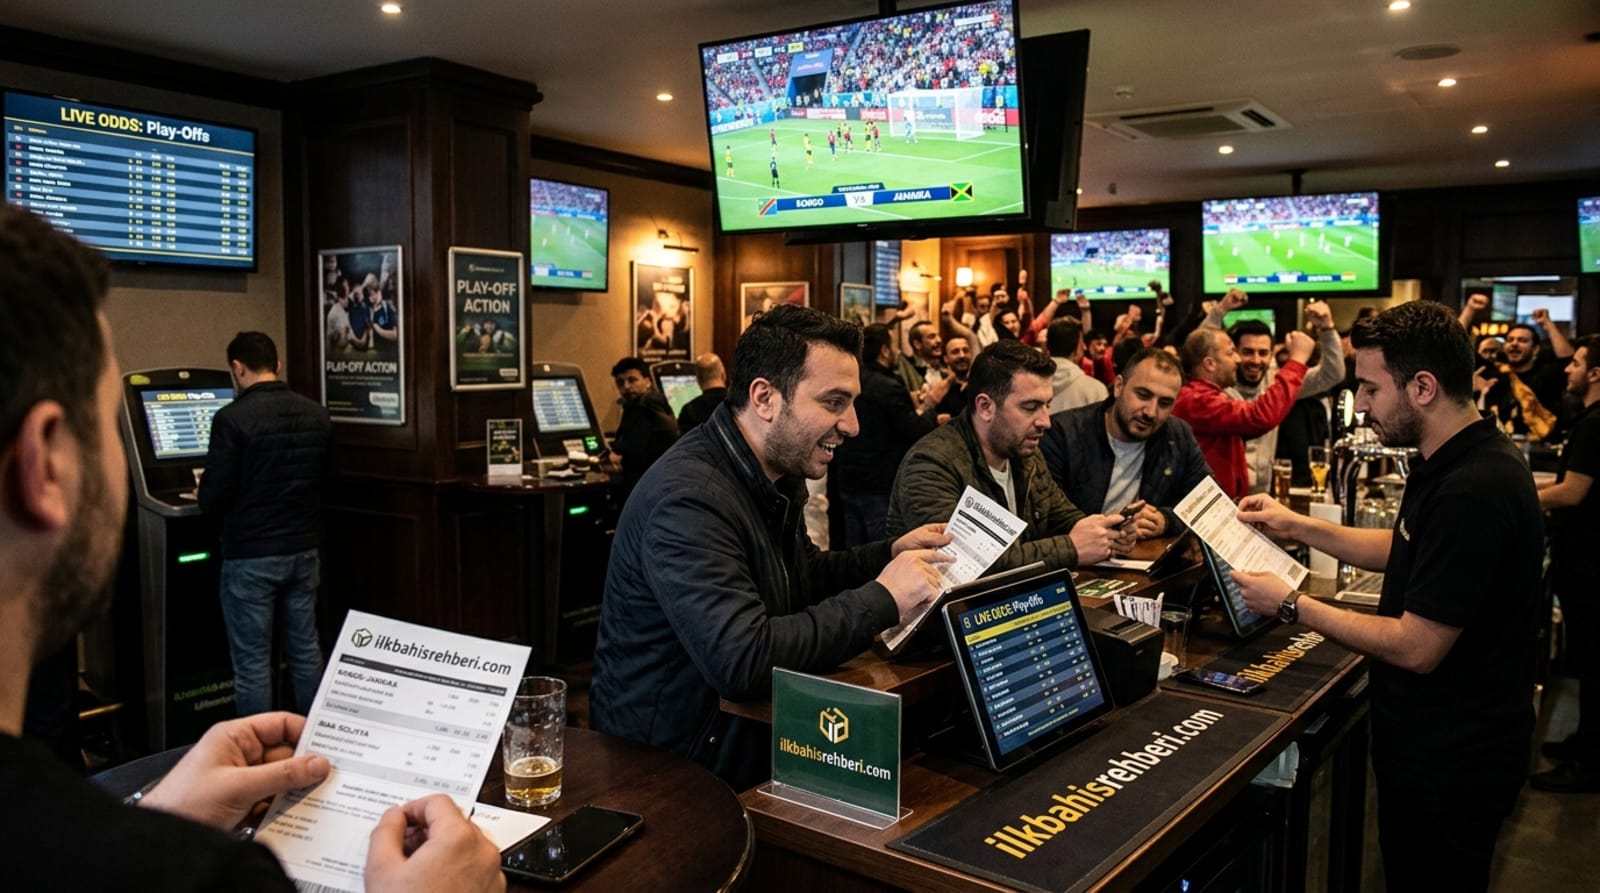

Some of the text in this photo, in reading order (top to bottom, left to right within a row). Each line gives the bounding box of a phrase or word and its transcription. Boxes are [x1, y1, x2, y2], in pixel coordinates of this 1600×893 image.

[60, 107, 210, 143] LIVE ODDS: Play-Offs
[457, 280, 516, 296] PLAY-OFF
[464, 299, 510, 314] ACTION
[374, 634, 512, 676] ilkbahisrehberi.com
[780, 737, 891, 781] ilkbahisrehberi.com
[984, 708, 1225, 860] ilkbahisrehberi.com
